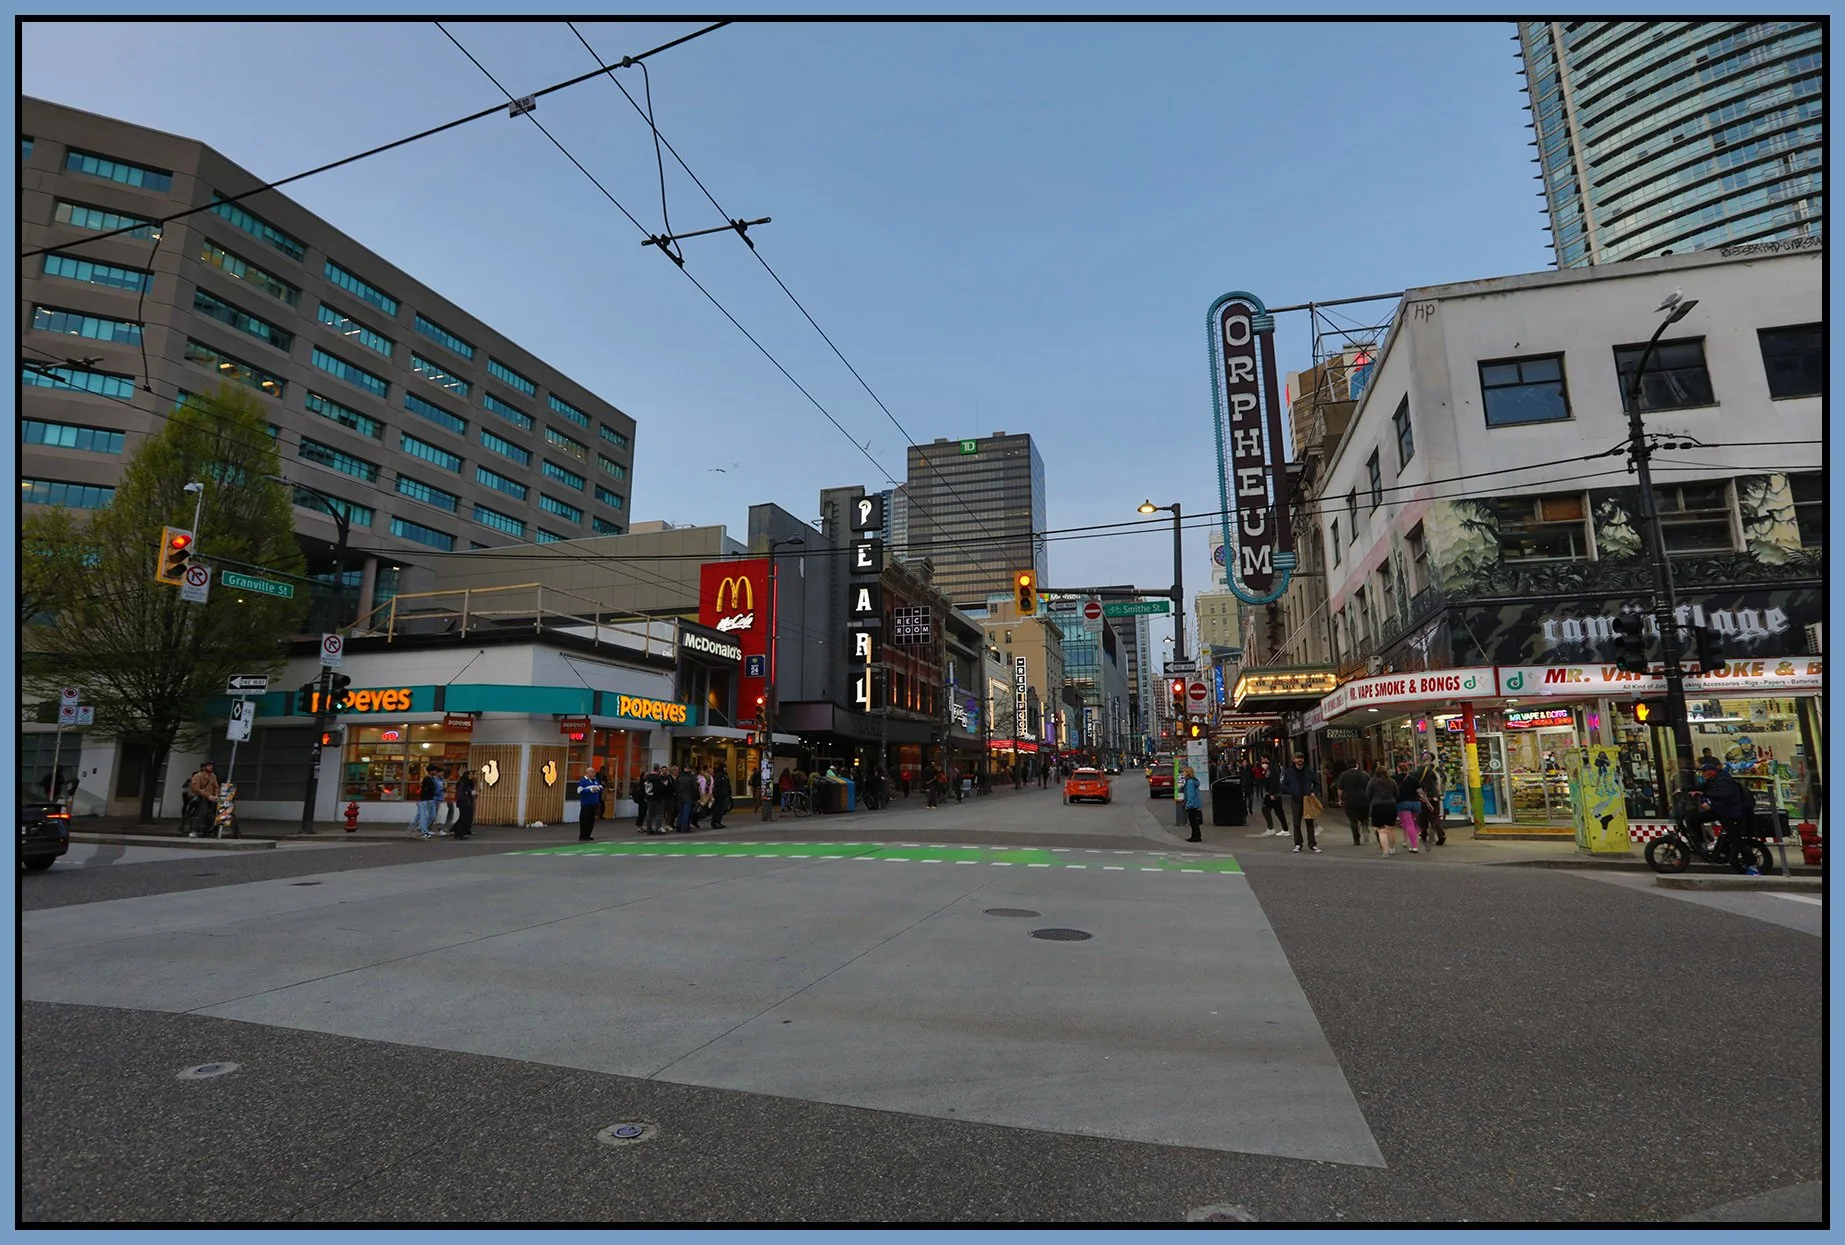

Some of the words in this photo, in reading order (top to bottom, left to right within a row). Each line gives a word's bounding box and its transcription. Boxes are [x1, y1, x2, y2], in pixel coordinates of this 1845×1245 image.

[961, 441, 976, 452] TD
[1225, 315, 1272, 575] ORPHEUM
[228, 575, 275, 593] Granville
[277, 586, 288, 596] St
[855, 500, 873, 703] PEARL
[1122, 603, 1151, 614] Smithe
[1152, 602, 1164, 612] St.
[896, 626, 929, 634] ROOM
[897, 617, 920, 625] REC
[1541, 602, 1791, 643] camflage
[684, 632, 742, 662] McDonald's
[1545, 667, 1590, 684] MR.
[1775, 661, 1795, 676] &
[1763, 679, 1786, 687] Papers
[1358, 685, 1373, 699] VAPE
[1375, 680, 1406, 697] SMOKE
[1409, 679, 1417, 694] &
[1420, 675, 1460, 693] BONGS
[1521, 712, 1540, 720] VAPE
